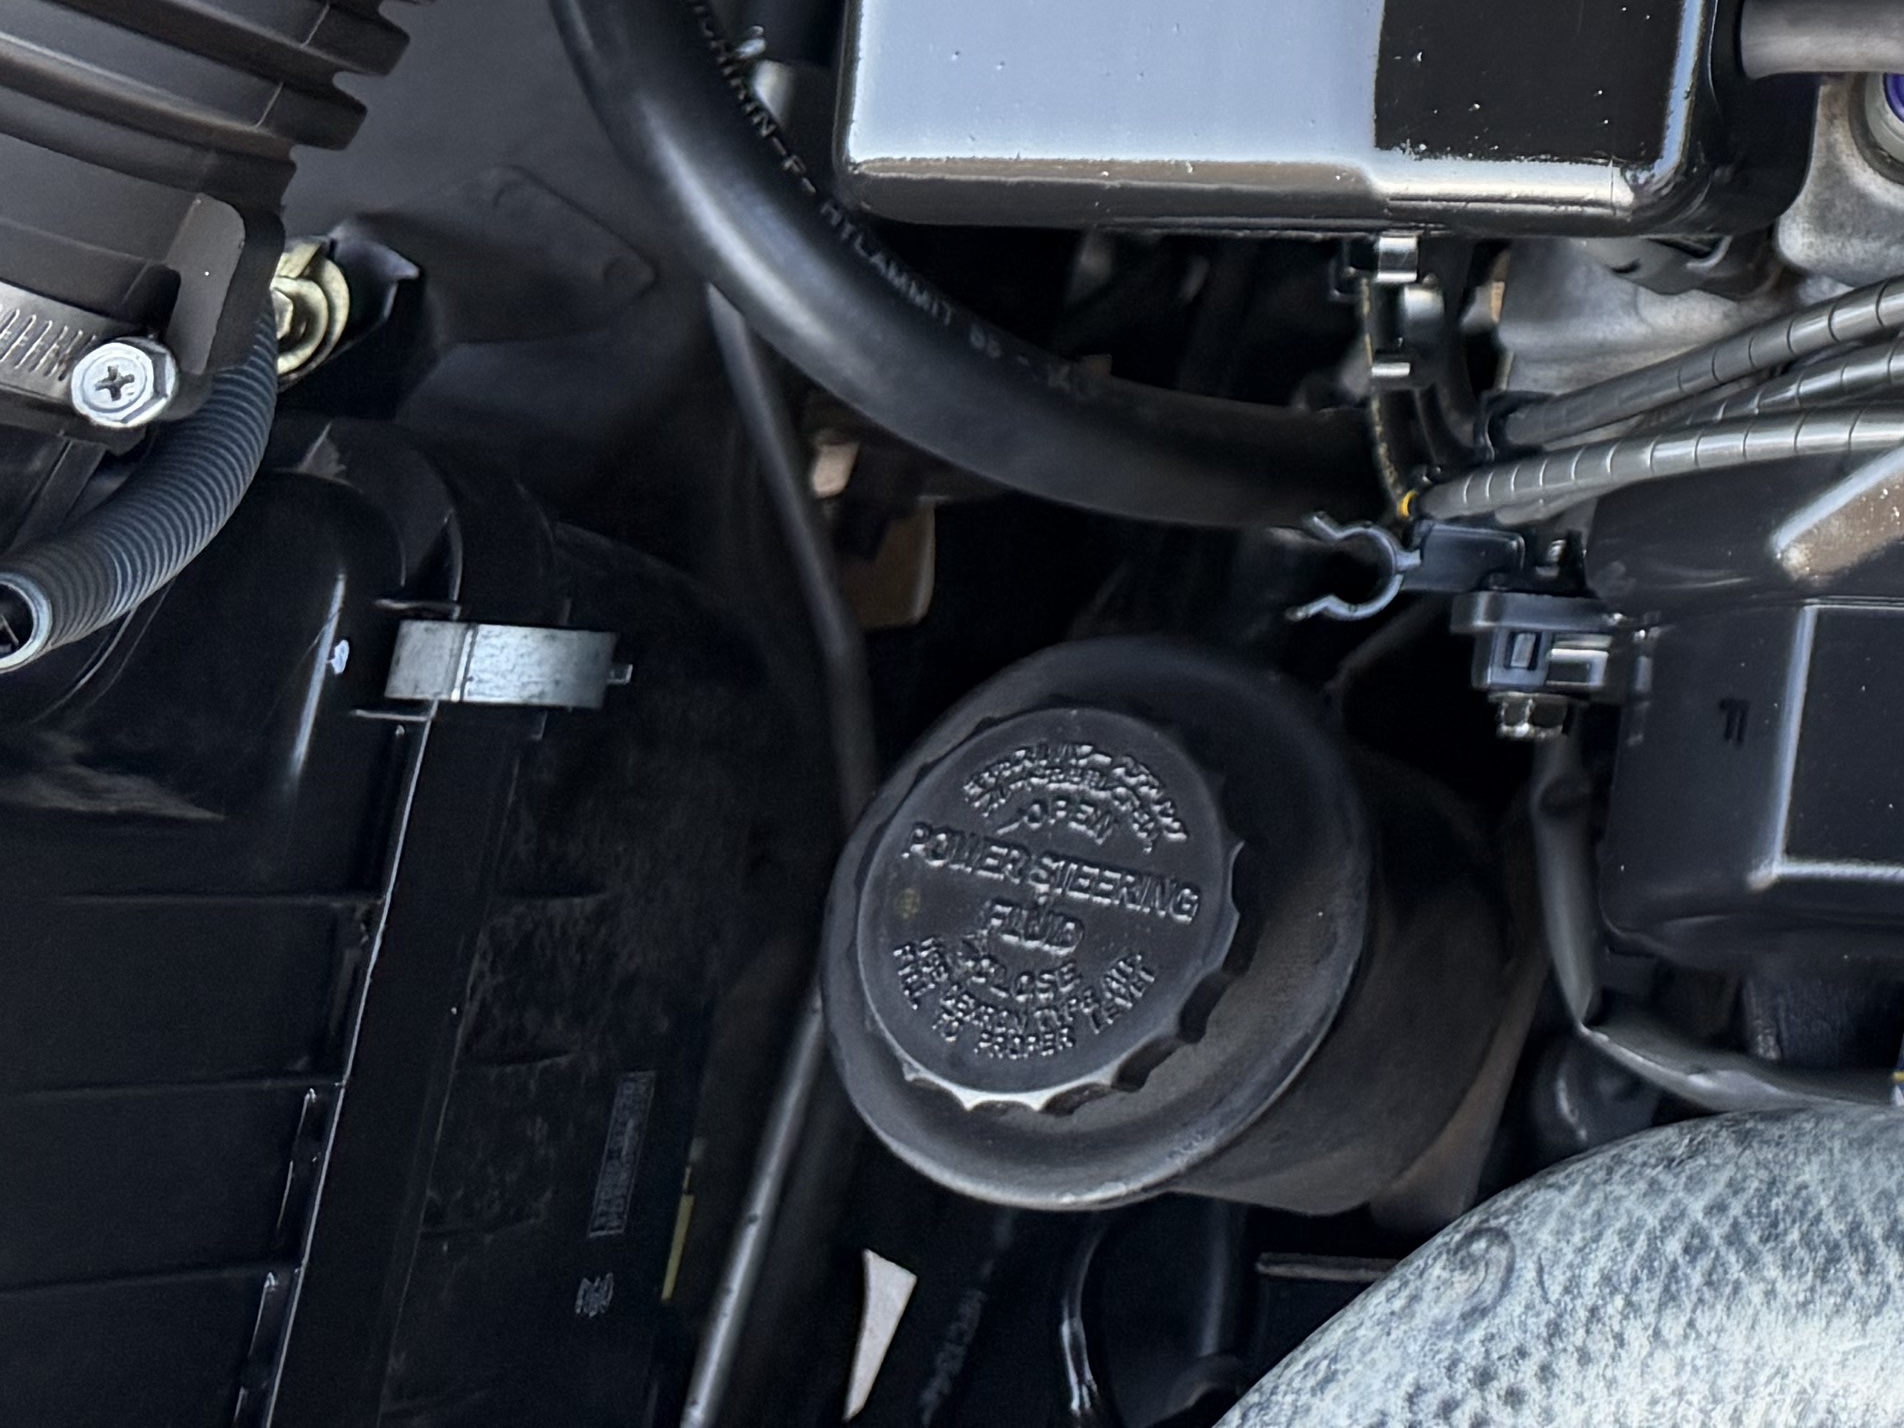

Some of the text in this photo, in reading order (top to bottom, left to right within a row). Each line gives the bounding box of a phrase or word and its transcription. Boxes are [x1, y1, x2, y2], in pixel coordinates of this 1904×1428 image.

[1020, 799, 1121, 846] OPEN
[902, 822, 1201, 923] POWER STEERING
[984, 899, 1085, 956] FLUID
